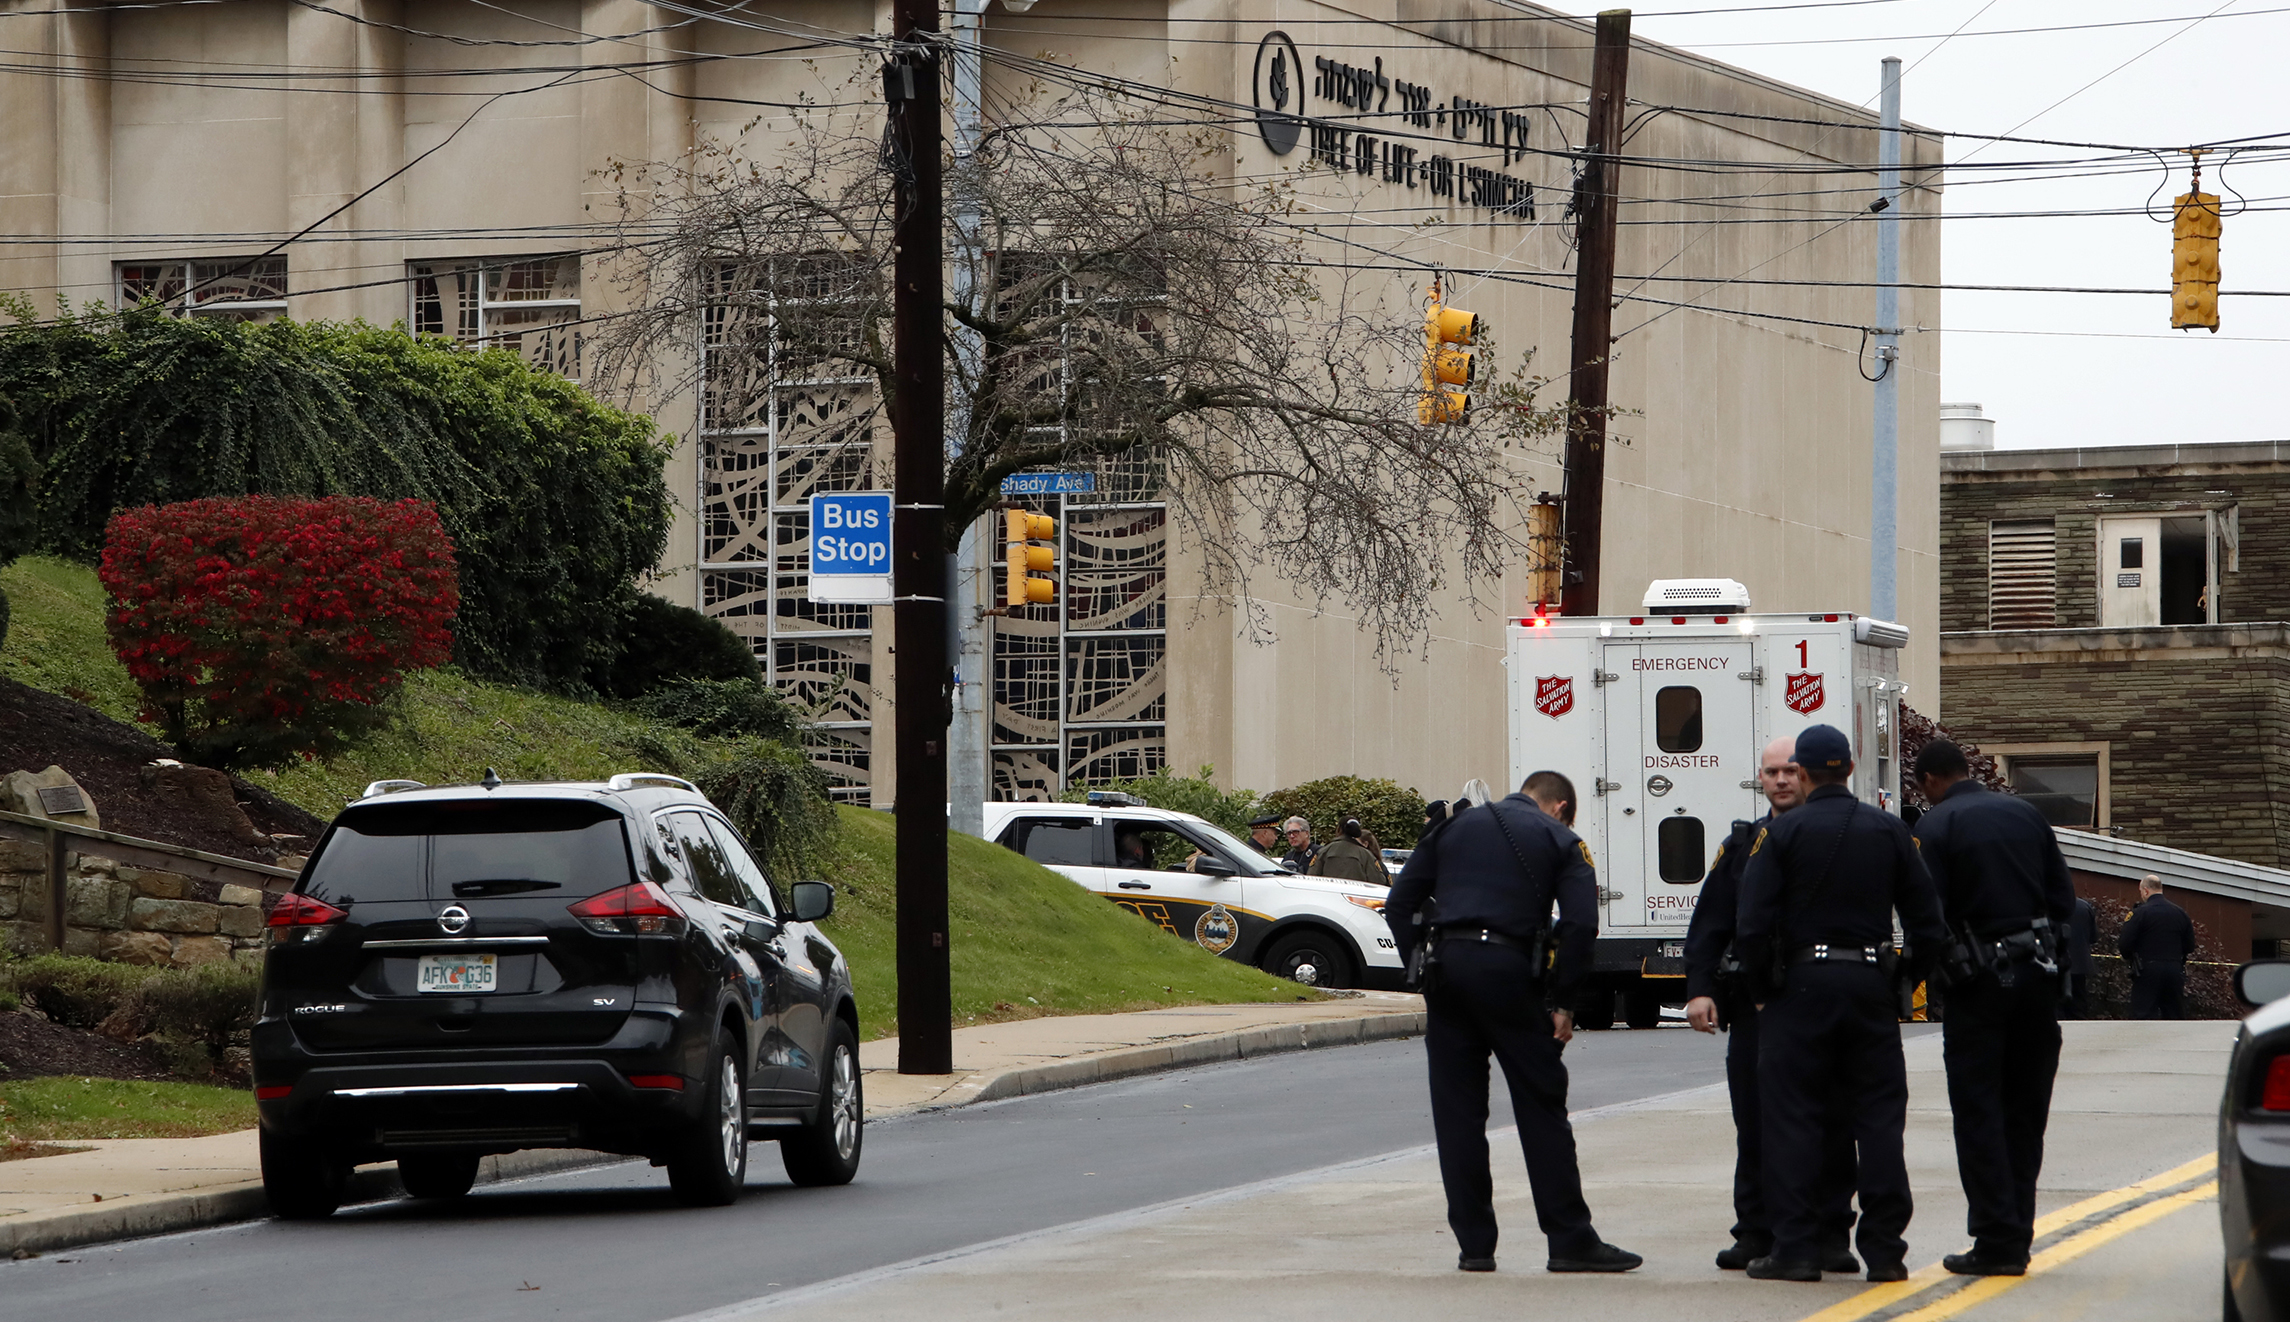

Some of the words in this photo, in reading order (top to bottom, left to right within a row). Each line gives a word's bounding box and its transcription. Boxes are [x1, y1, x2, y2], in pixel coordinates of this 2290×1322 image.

[1308, 119, 1351, 171] TREE
[1355, 134, 1379, 177] OF
[1383, 141, 1418, 189] LIFE
[1430, 153, 1454, 199] OR
[1001, 476, 1048, 493] Shady
[1056, 476, 1084, 490] Ave
[823, 503, 879, 529] Bus
[817, 535, 886, 566] Stop
[1632, 657, 1729, 671] EMERGENCY
[1794, 639, 1807, 669] 1
[1542, 679, 1557, 693] THE
[1787, 677, 1820, 705] SALVATION
[1792, 675, 1807, 690] THE
[1537, 681, 1570, 708] SALVATION
[1549, 693, 1569, 713] ARMY
[1799, 690, 1820, 710] ARMY
[1645, 755, 1719, 768] DISASTER
[294, 1004, 346, 1015] ROGUE
[593, 998, 616, 1007] SV
